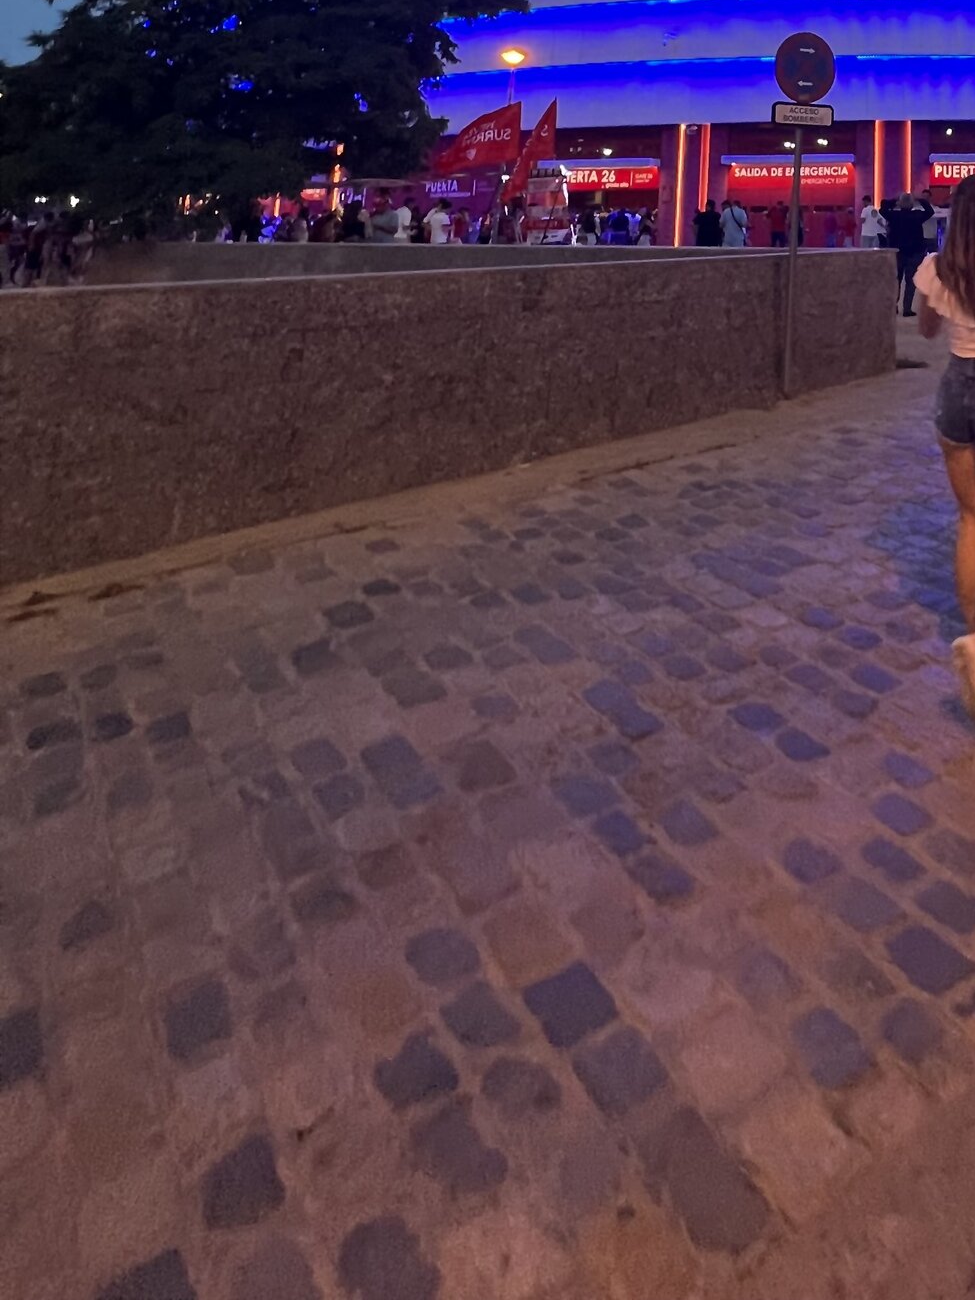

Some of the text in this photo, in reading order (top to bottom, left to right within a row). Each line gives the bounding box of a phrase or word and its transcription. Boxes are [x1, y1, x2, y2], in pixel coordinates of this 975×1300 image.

[566, 169, 616, 183] ERTA 26
[734, 167, 768, 177] SALIDA
[771, 167, 783, 177] DE
